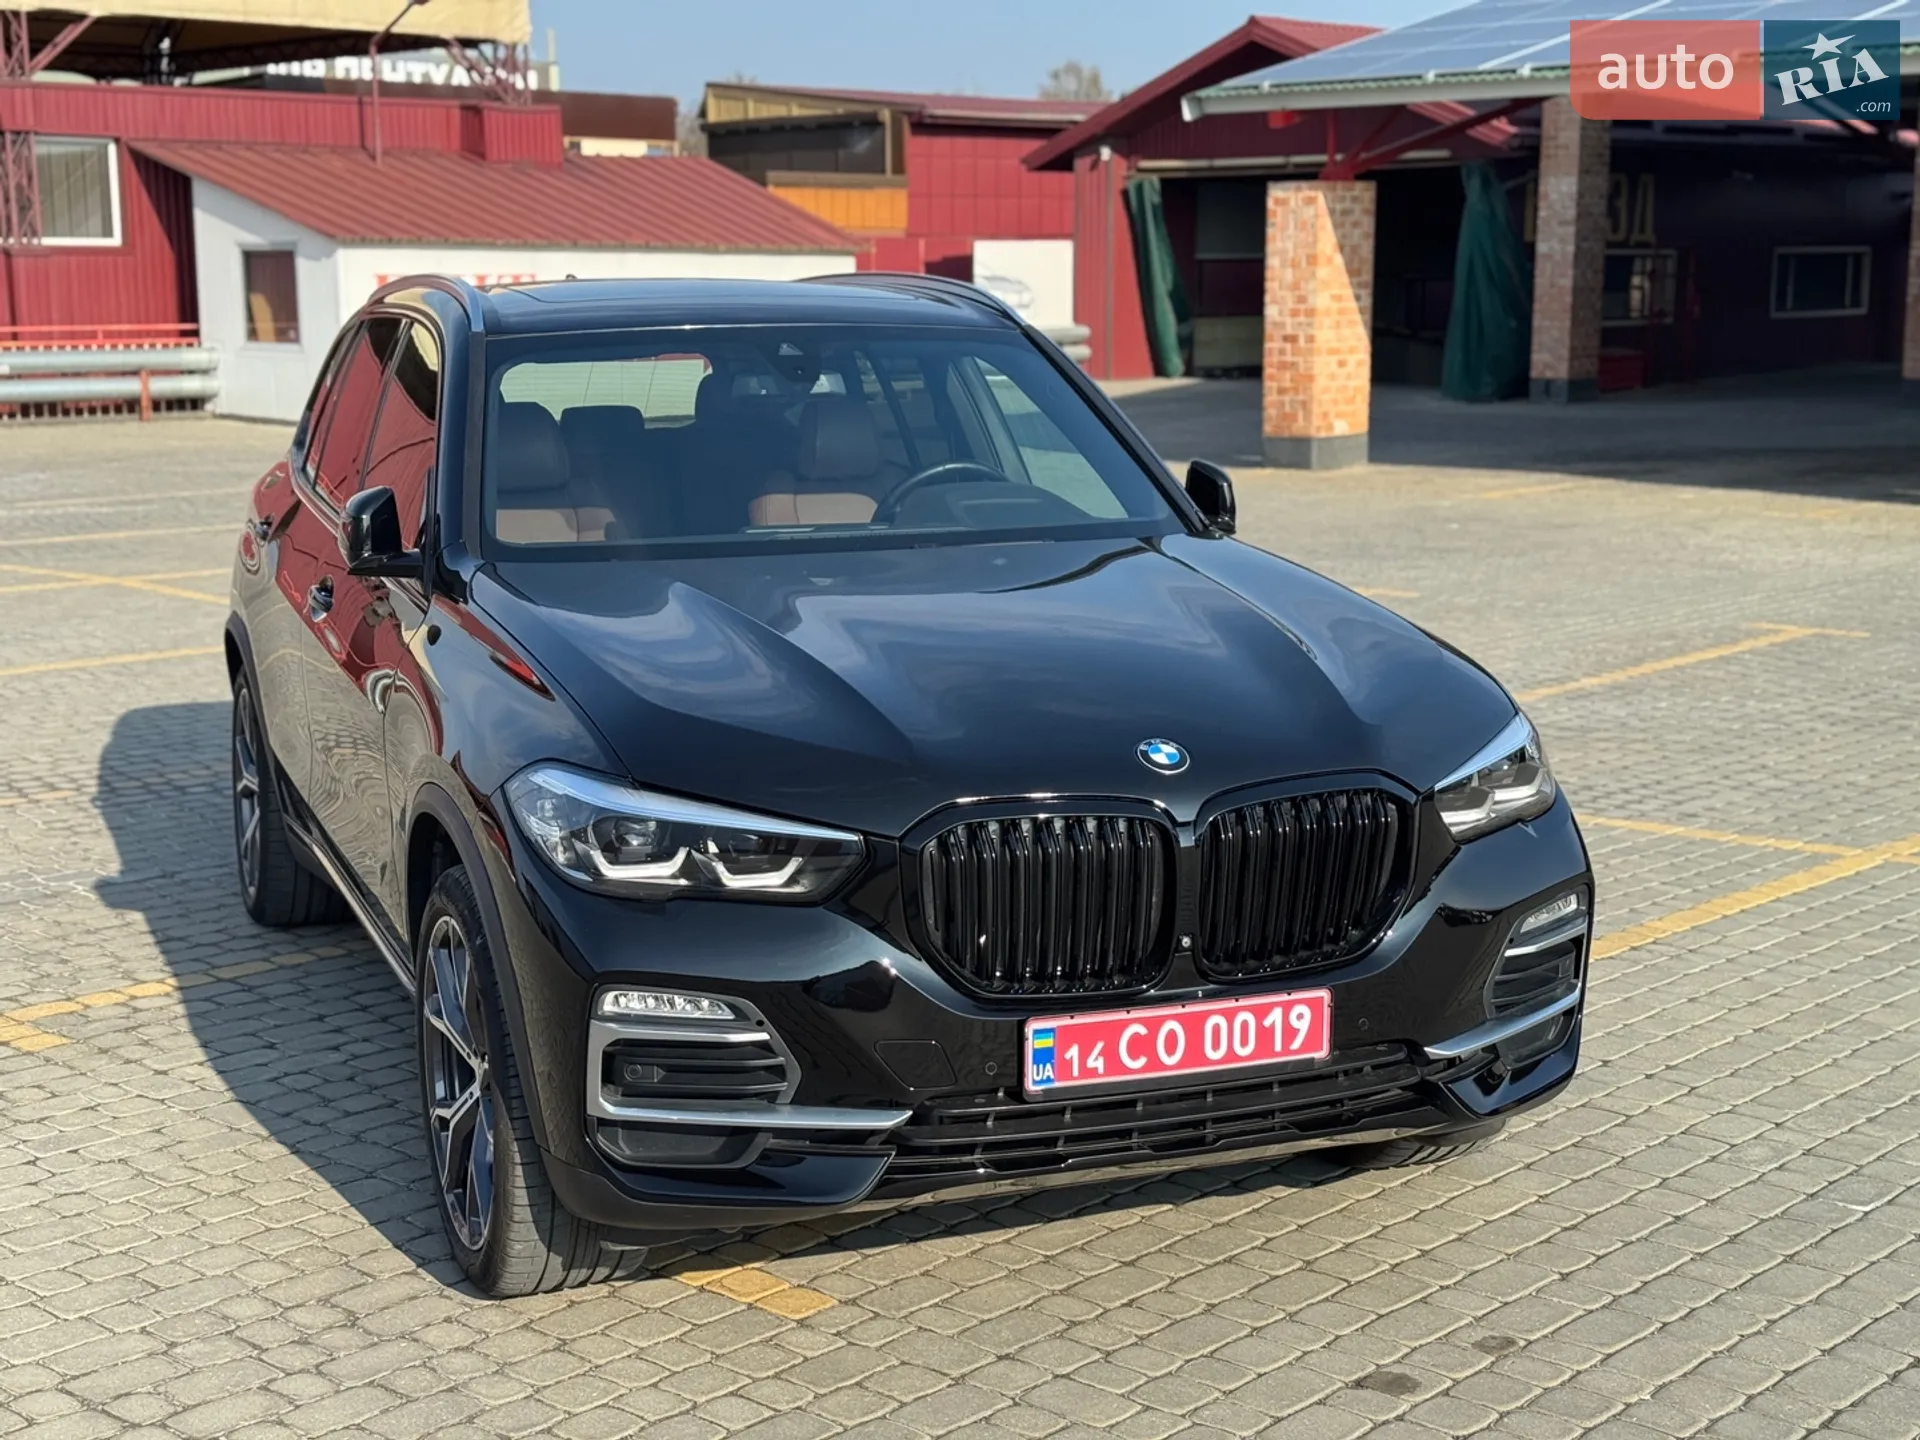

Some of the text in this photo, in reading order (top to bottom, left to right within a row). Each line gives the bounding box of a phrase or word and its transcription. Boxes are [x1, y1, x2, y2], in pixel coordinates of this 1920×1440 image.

[1064, 1004, 1312, 1077] 14 CO 0019
[1033, 1063, 1054, 1081] UA
